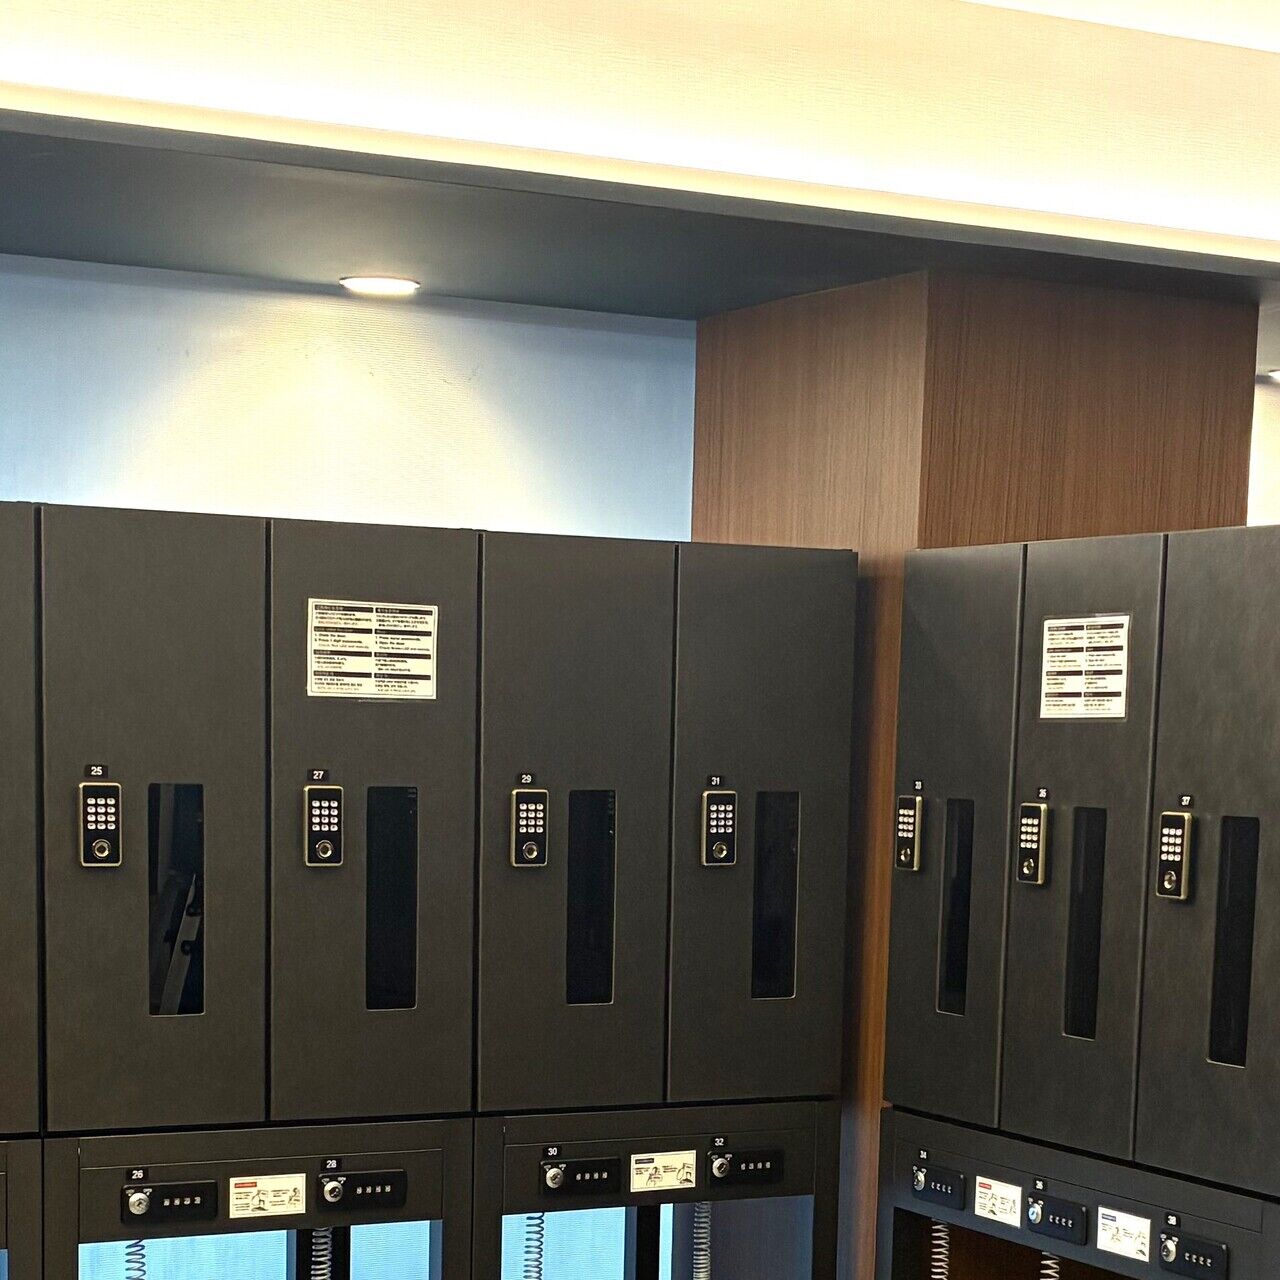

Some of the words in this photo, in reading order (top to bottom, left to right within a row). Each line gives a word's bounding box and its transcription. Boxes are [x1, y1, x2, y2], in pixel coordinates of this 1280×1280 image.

[90, 766, 103, 776] 25
[313, 770, 324, 780] 27
[521, 774, 532, 784] 29
[711, 776, 720, 786] 31
[1181, 796, 1191, 806] 37
[714, 1137, 724, 1147] 32
[547, 1147, 558, 1156] 30
